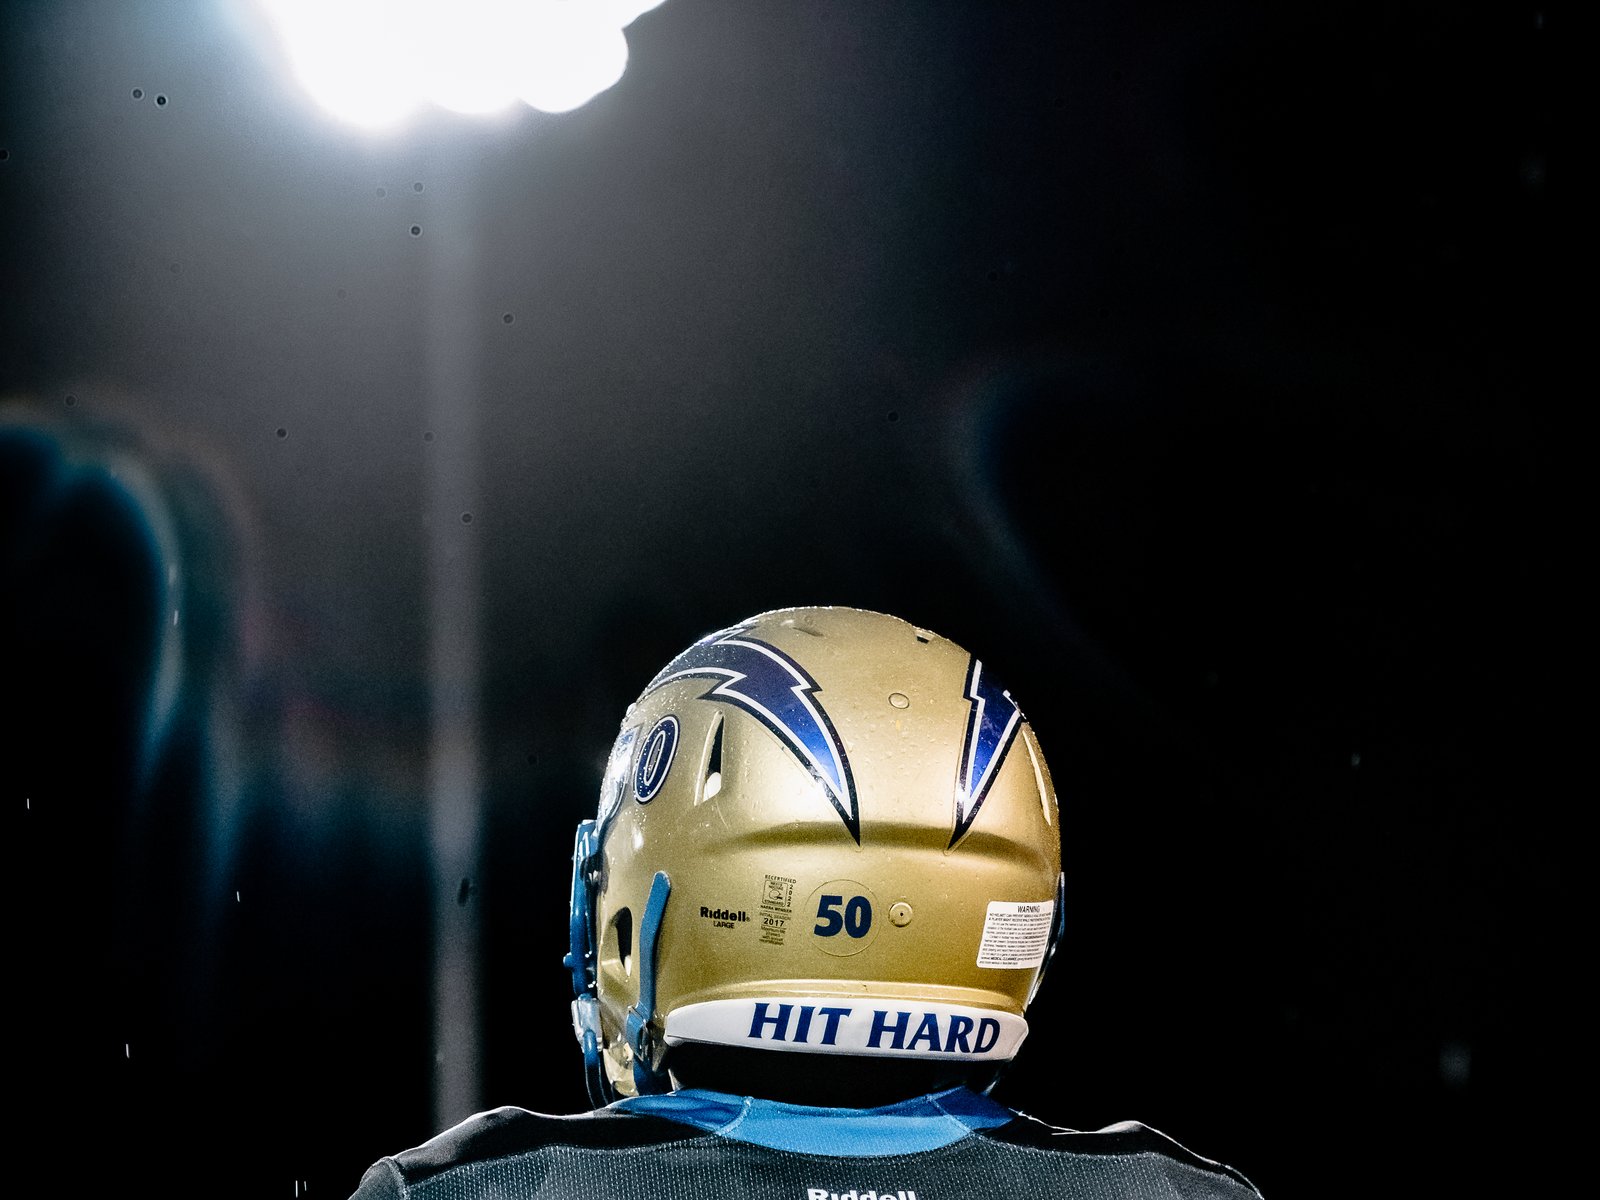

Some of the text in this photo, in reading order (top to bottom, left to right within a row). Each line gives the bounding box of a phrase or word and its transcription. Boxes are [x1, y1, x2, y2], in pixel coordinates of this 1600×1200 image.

[764, 874, 797, 884] RECERTIFIED
[700, 906, 747, 922] Riddell
[1017, 905, 1041, 913] WARNING
[813, 894, 873, 939] 50
[713, 921, 735, 929] LARGE
[763, 917, 785, 927] 2017
[748, 1002, 1000, 1054] HIT HARD
